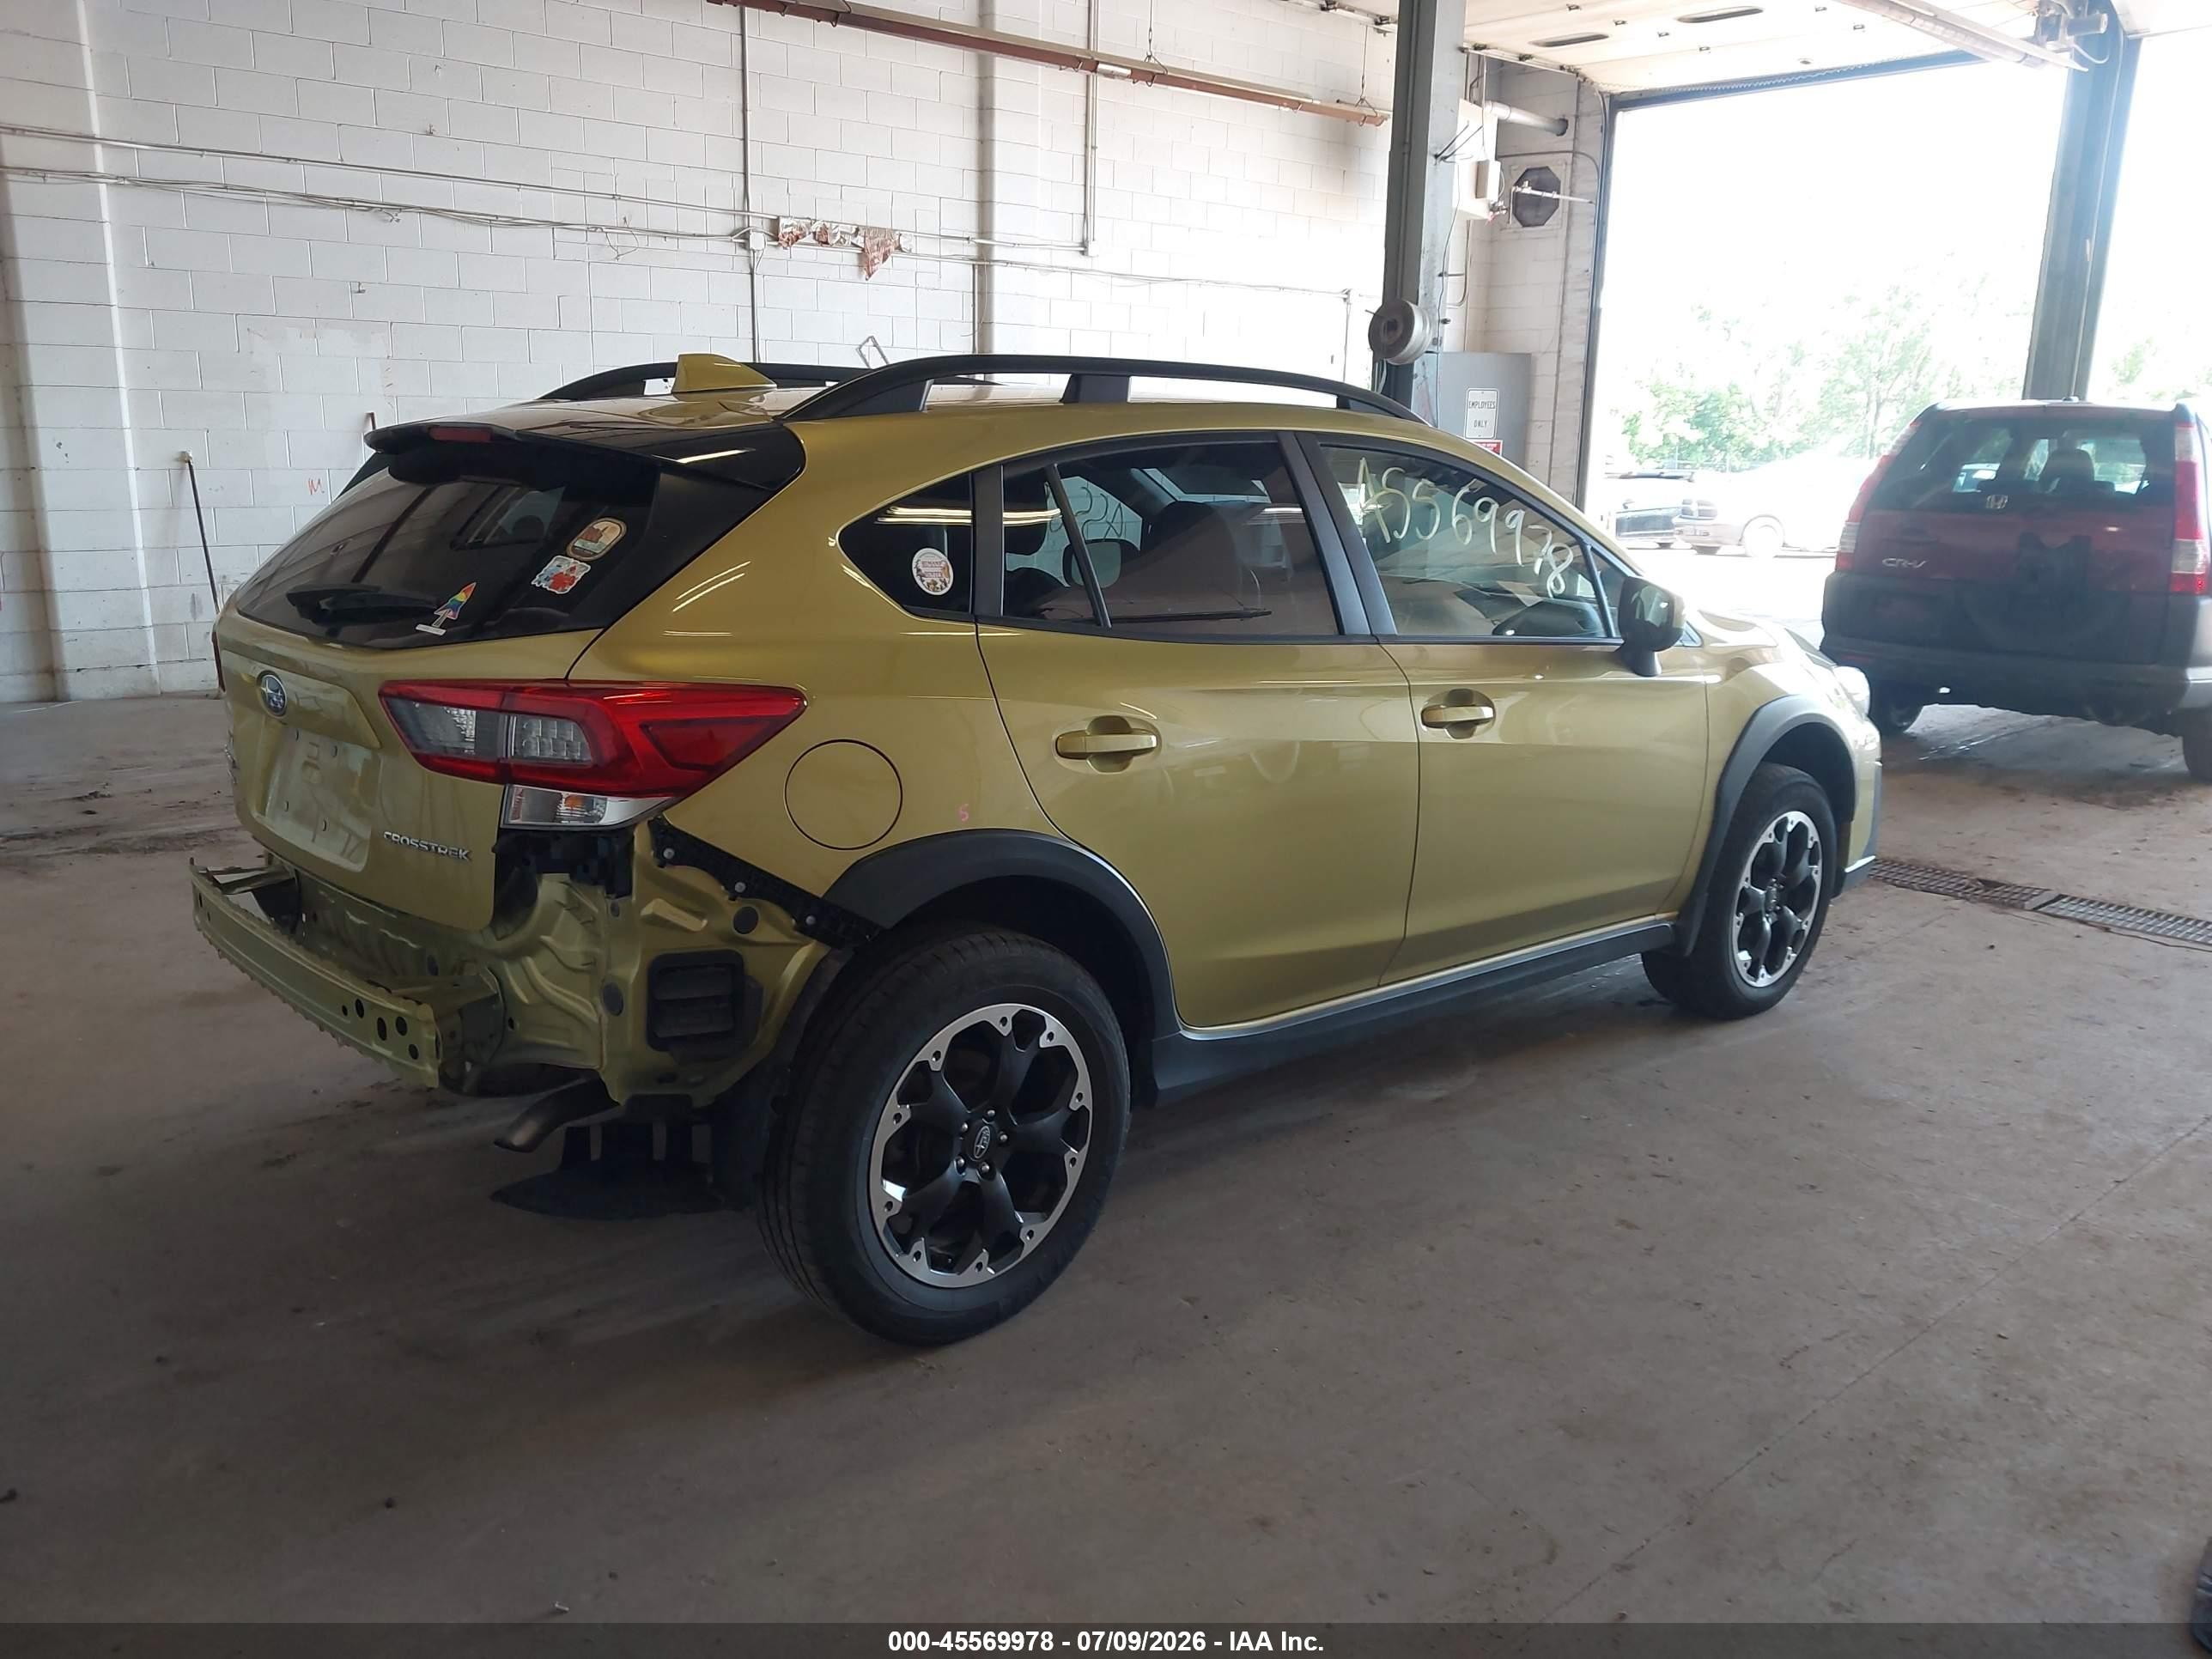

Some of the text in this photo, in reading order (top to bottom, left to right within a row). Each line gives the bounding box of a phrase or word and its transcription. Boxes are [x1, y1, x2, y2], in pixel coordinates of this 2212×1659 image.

[1468, 400, 1496, 409] EMPLOYEES
[1474, 420, 1488, 428] ONLY
[1881, 556, 1928, 568] CR-V
[383, 830, 472, 861] CROSSTREK
